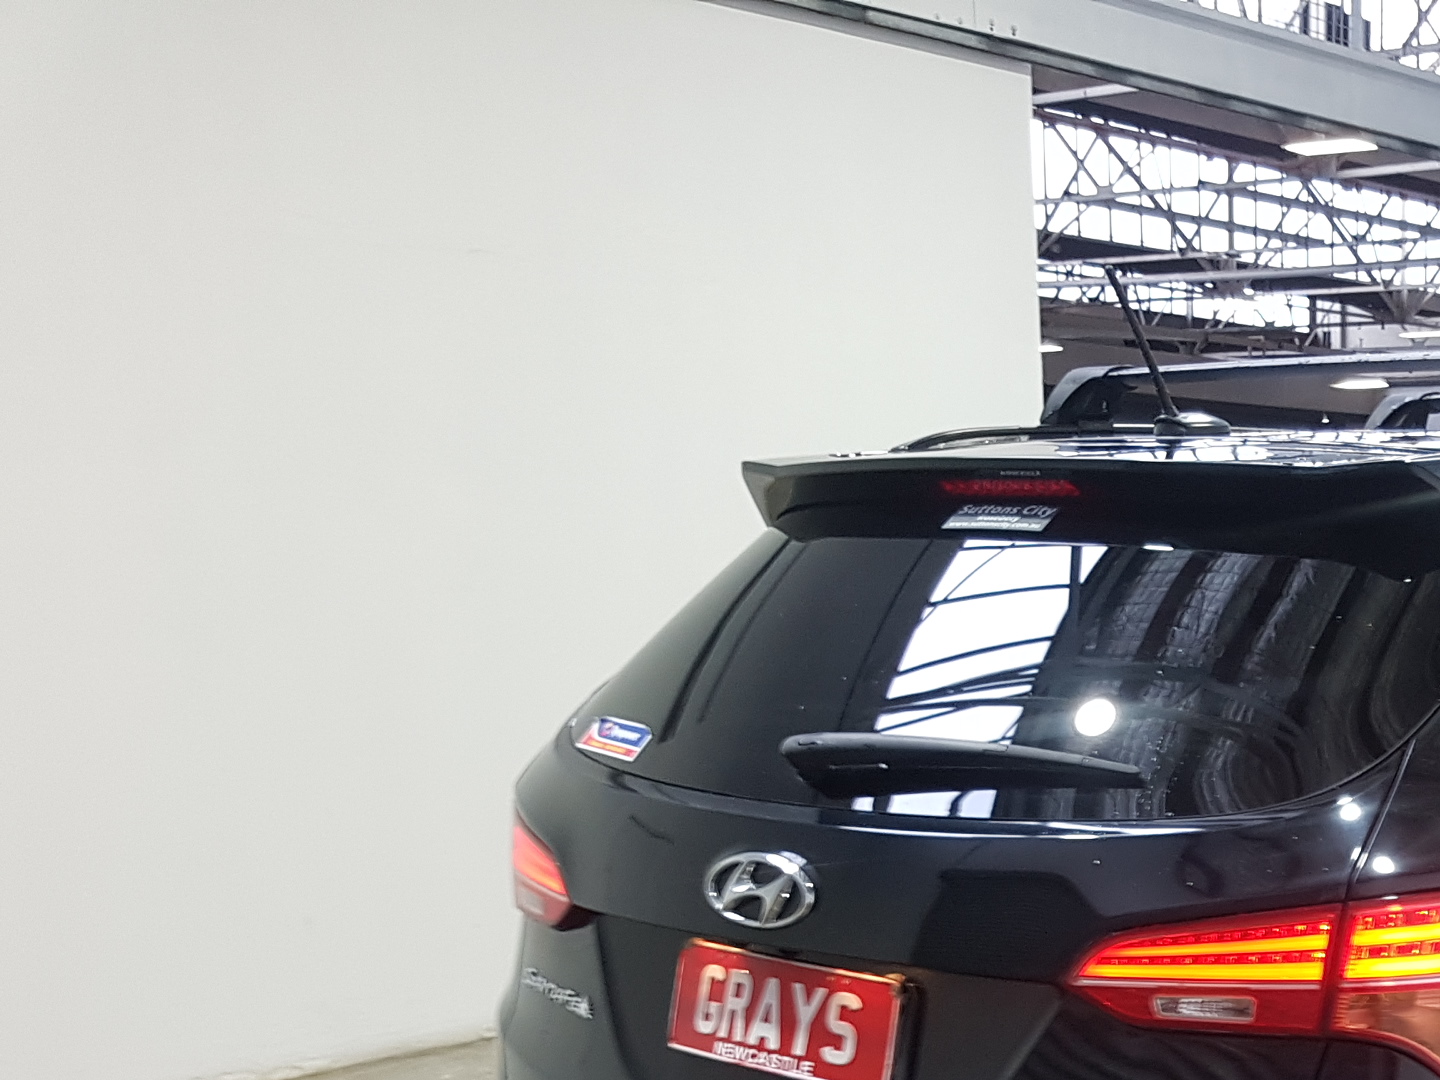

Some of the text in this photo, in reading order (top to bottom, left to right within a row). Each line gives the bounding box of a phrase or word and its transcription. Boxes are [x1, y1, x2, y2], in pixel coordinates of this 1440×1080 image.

[959, 504, 1058, 519] Suttons City
[693, 963, 865, 1067] GRAYS
[711, 1041, 817, 1077] NEWCASTLE
